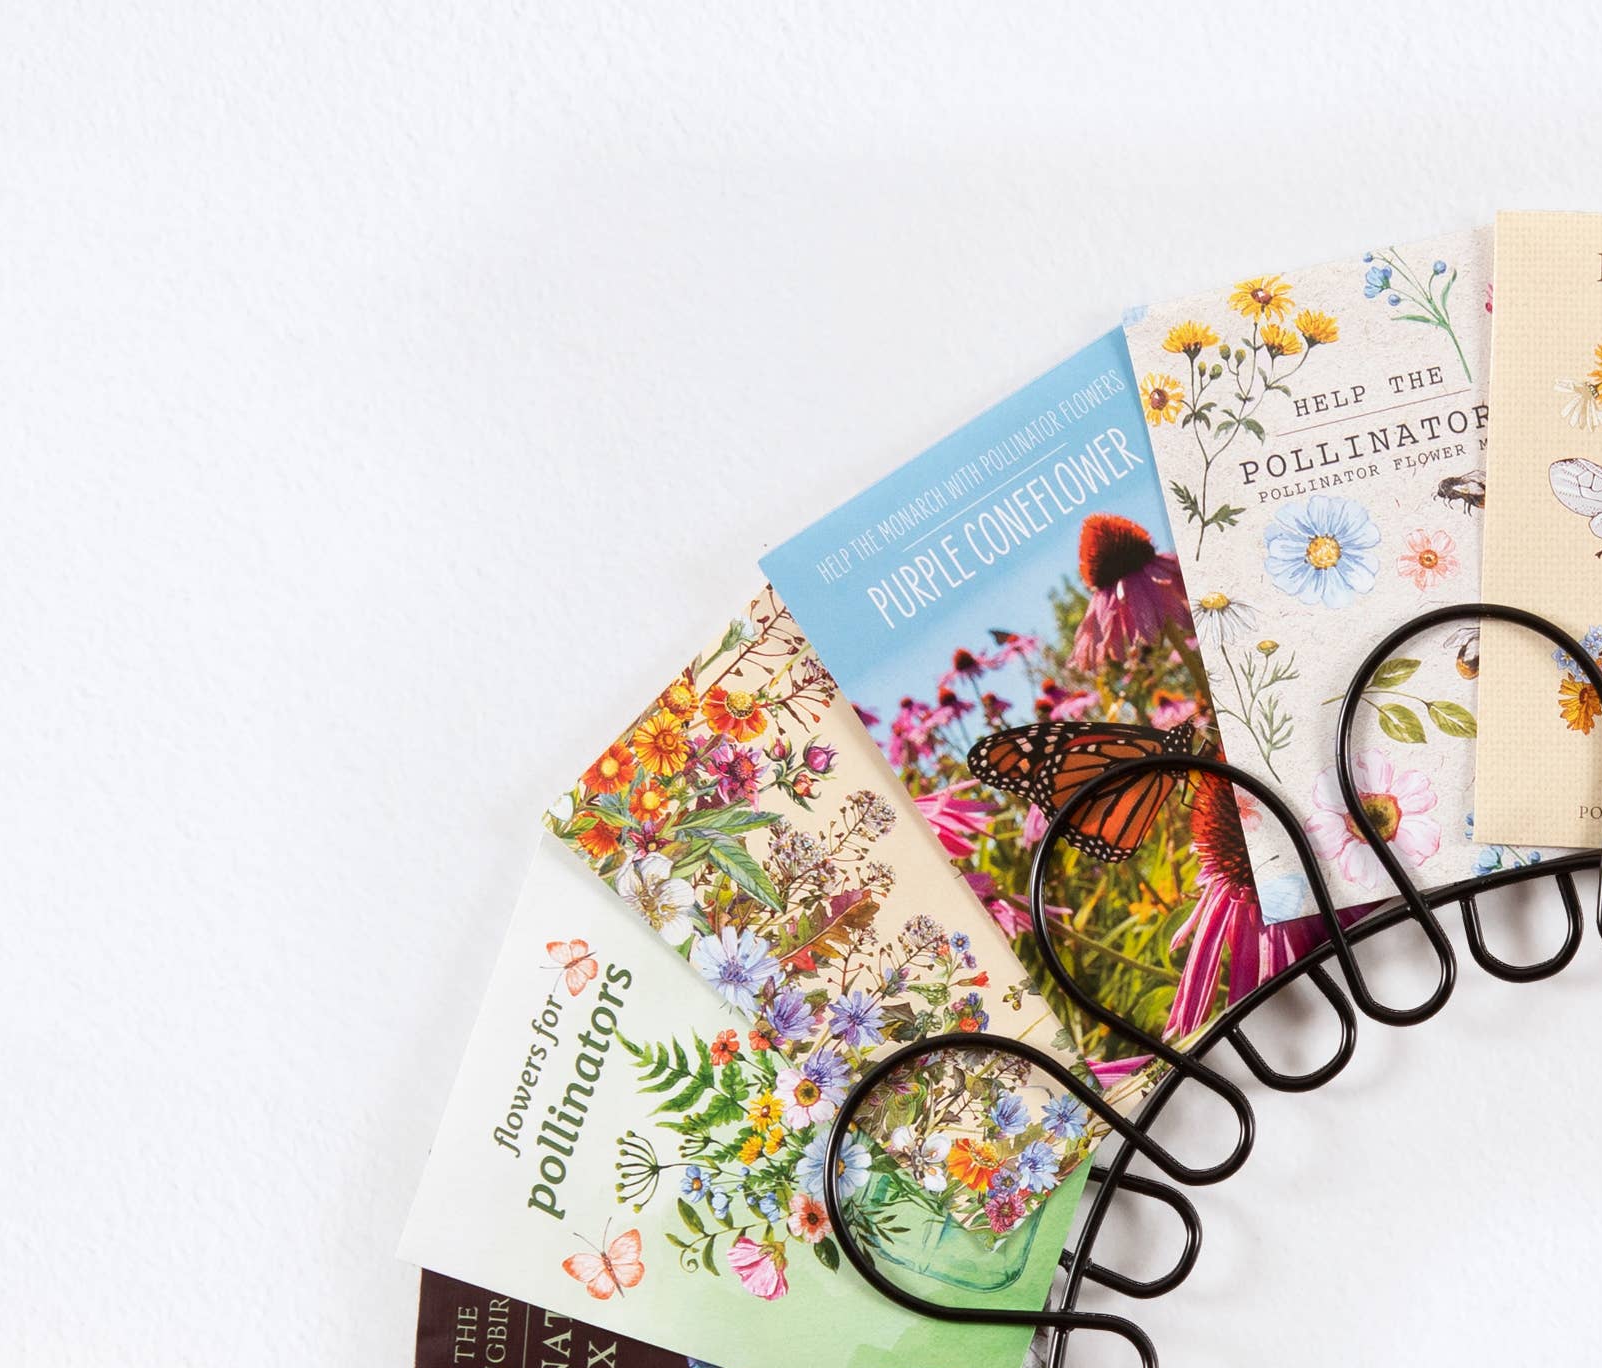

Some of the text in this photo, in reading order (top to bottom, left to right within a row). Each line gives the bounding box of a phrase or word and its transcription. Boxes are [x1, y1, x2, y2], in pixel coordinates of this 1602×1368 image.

[1259, 444, 1467, 503] POLLINATOR FLOWER
[1293, 366, 1444, 417] HELP THE
[816, 367, 1125, 584] HELP THE MONARCH WITH POLLINATOR FLOWERS
[866, 428, 1144, 630] PURPLE CONEFLOWER
[493, 994, 563, 1158] flowers for
[527, 963, 632, 1220] pollinators
[454, 1305, 478, 1363] THE
